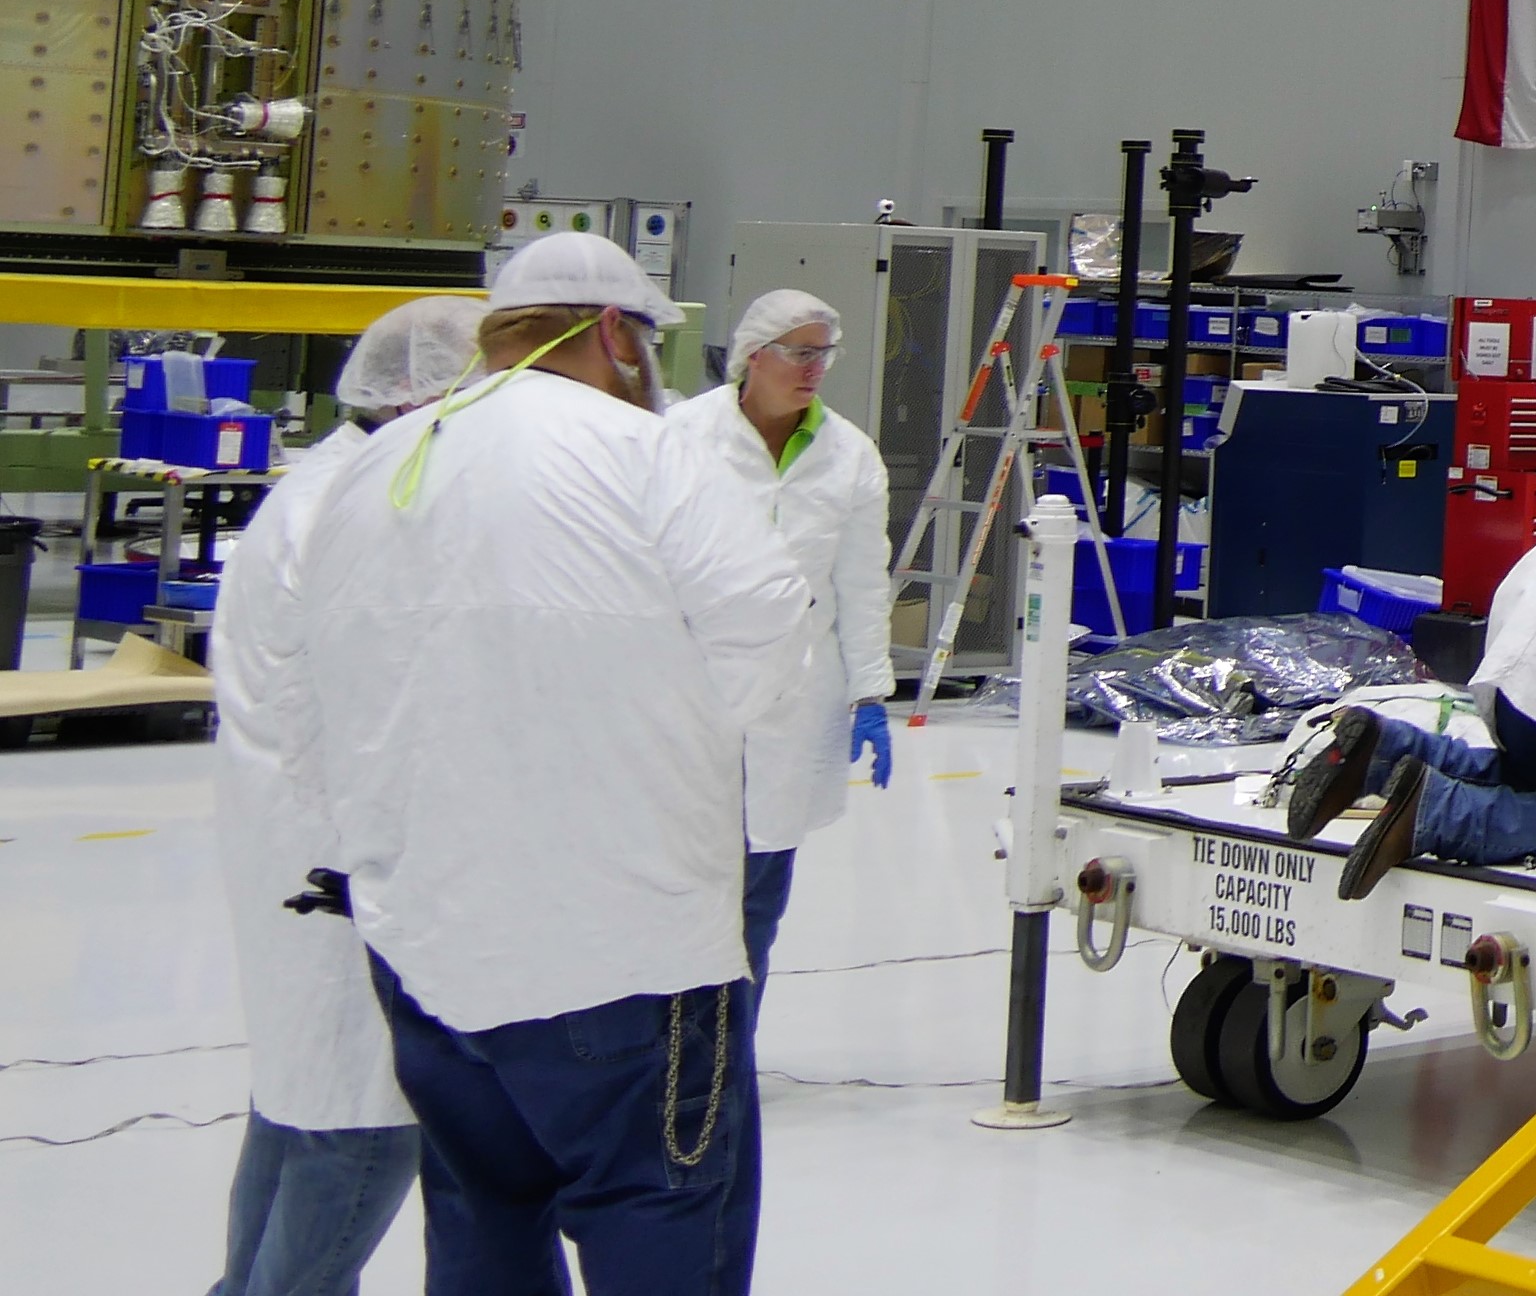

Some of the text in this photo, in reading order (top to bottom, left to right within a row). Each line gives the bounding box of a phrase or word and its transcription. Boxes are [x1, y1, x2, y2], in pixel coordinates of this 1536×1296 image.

[1193, 836, 1315, 883] TIE DOWN ONLY
[1216, 873, 1292, 911] CAPACITY
[1209, 905, 1296, 946] 15,000 LBS
